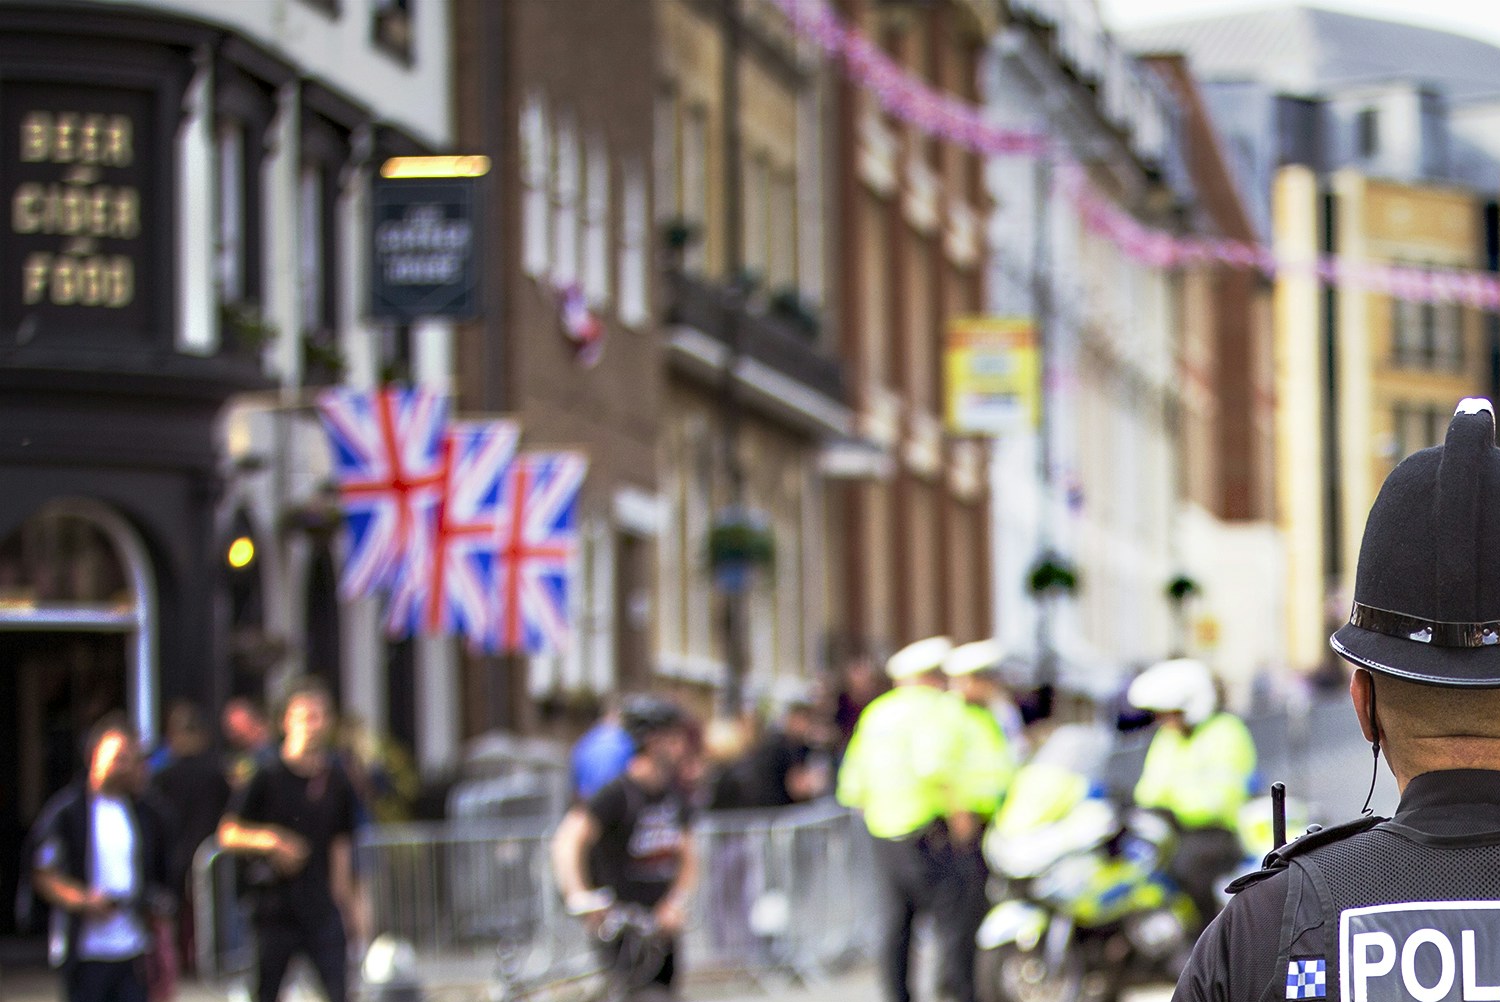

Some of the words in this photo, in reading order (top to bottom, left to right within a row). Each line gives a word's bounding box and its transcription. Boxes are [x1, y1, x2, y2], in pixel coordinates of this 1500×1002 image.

[20, 112, 133, 167] BEER
[12, 182, 140, 239] CIDER
[23, 252, 135, 308] FOOD
